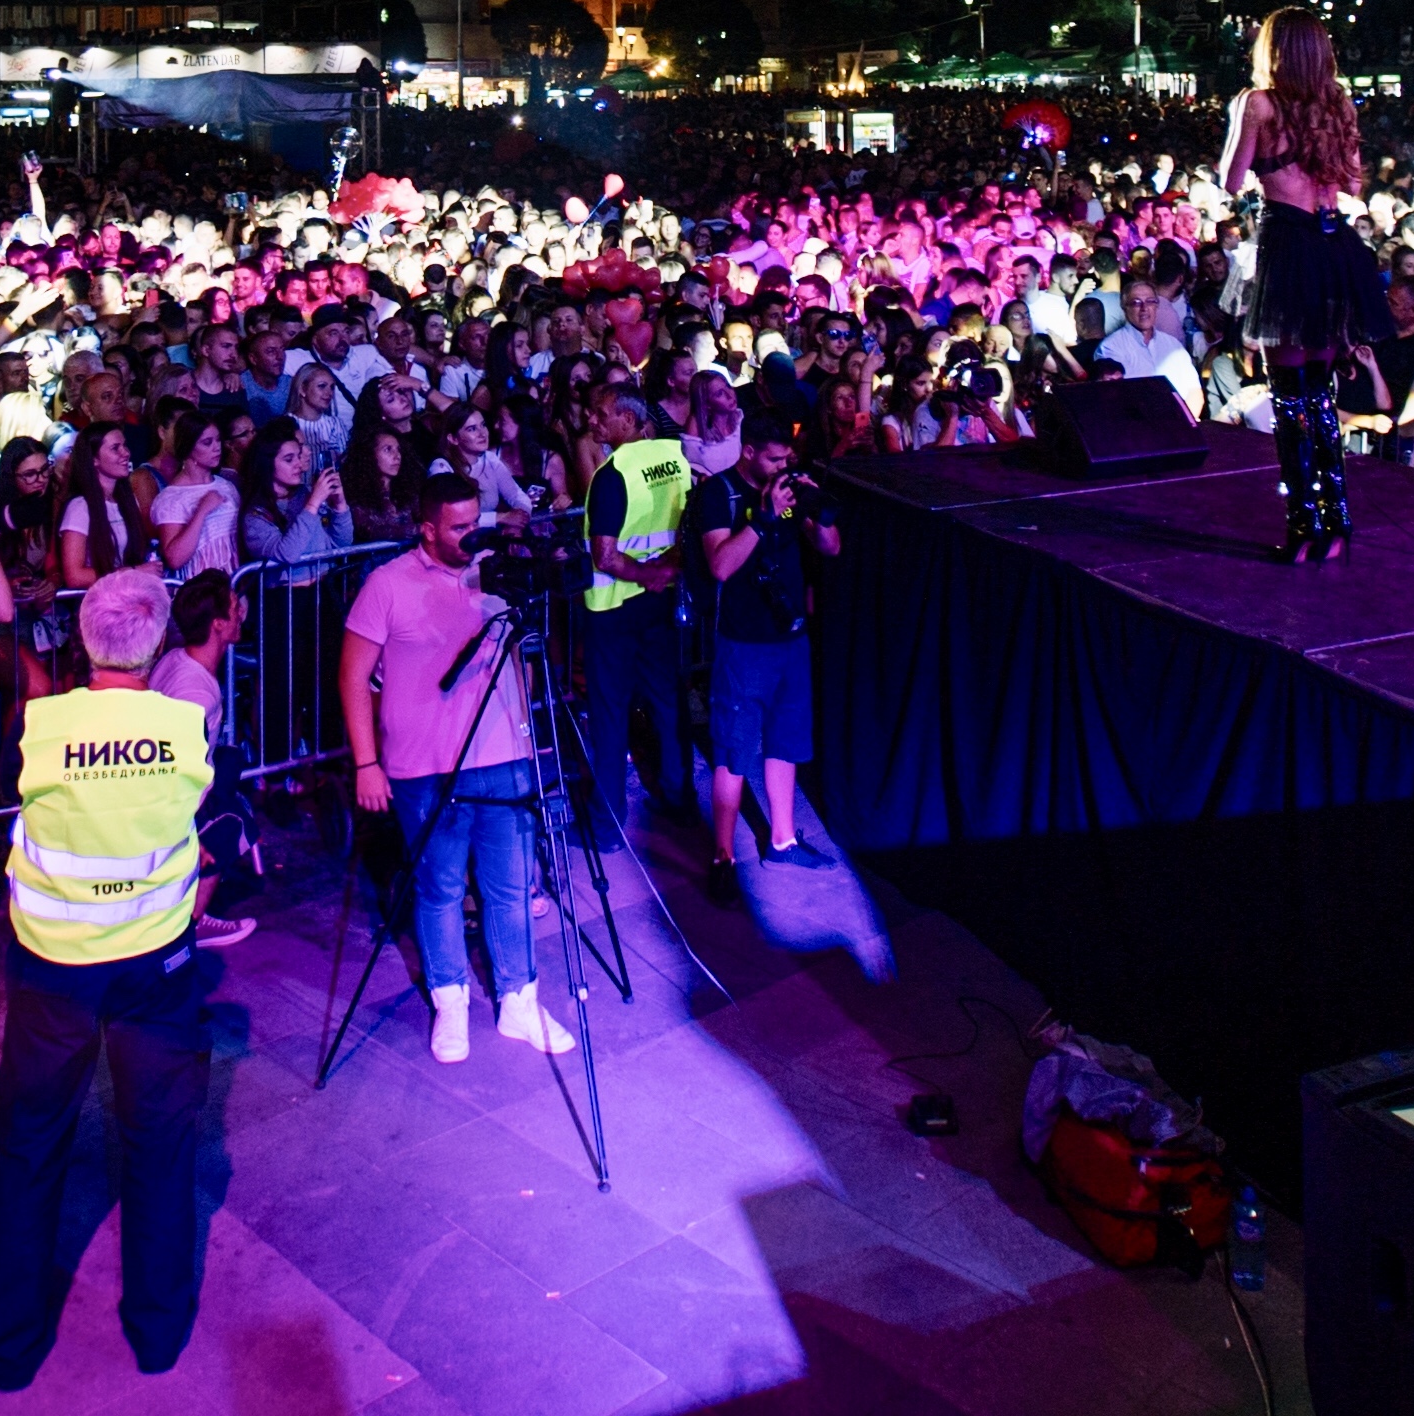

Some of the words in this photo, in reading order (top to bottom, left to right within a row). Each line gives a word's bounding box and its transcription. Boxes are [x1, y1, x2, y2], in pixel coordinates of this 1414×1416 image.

[183, 55, 219, 66] ZLATEN
[221, 54, 241, 66] DAB
[641, 460, 682, 483] НИКОБ
[64, 739, 175, 768] НИКОБ
[64, 766, 178, 782] ОБЕЗБЕДУВАЊЕ
[91, 881, 134, 896] 1003
